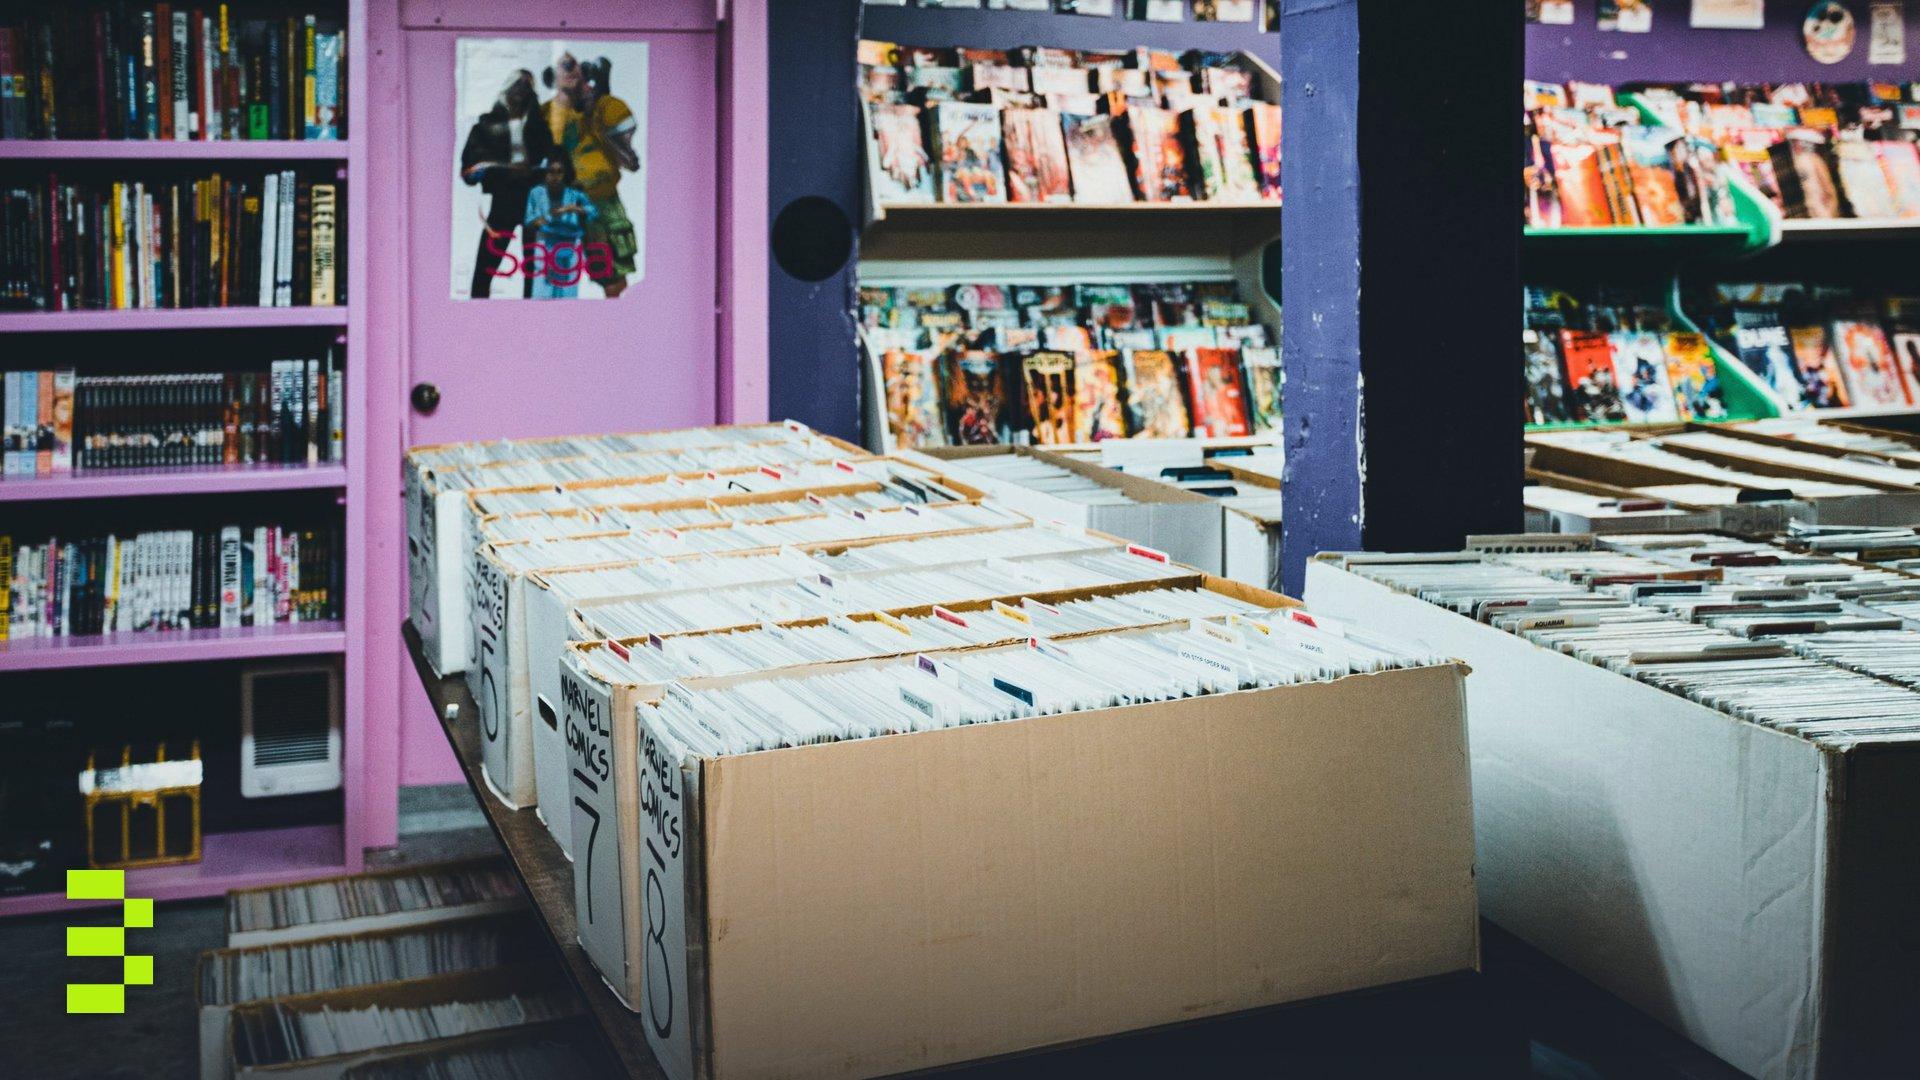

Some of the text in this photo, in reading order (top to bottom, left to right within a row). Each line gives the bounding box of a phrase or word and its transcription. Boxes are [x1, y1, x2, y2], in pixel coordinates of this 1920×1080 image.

[486, 230, 613, 288] Saga
[1534, 619, 1565, 628] AQUAMAN
[561, 674, 609, 738] MARVEL
[565, 714, 610, 782] COMICS
[639, 728, 679, 801] MARVEL
[640, 768, 681, 859] COMICS
[574, 796, 600, 925] 7
[646, 867, 673, 1039] 8
